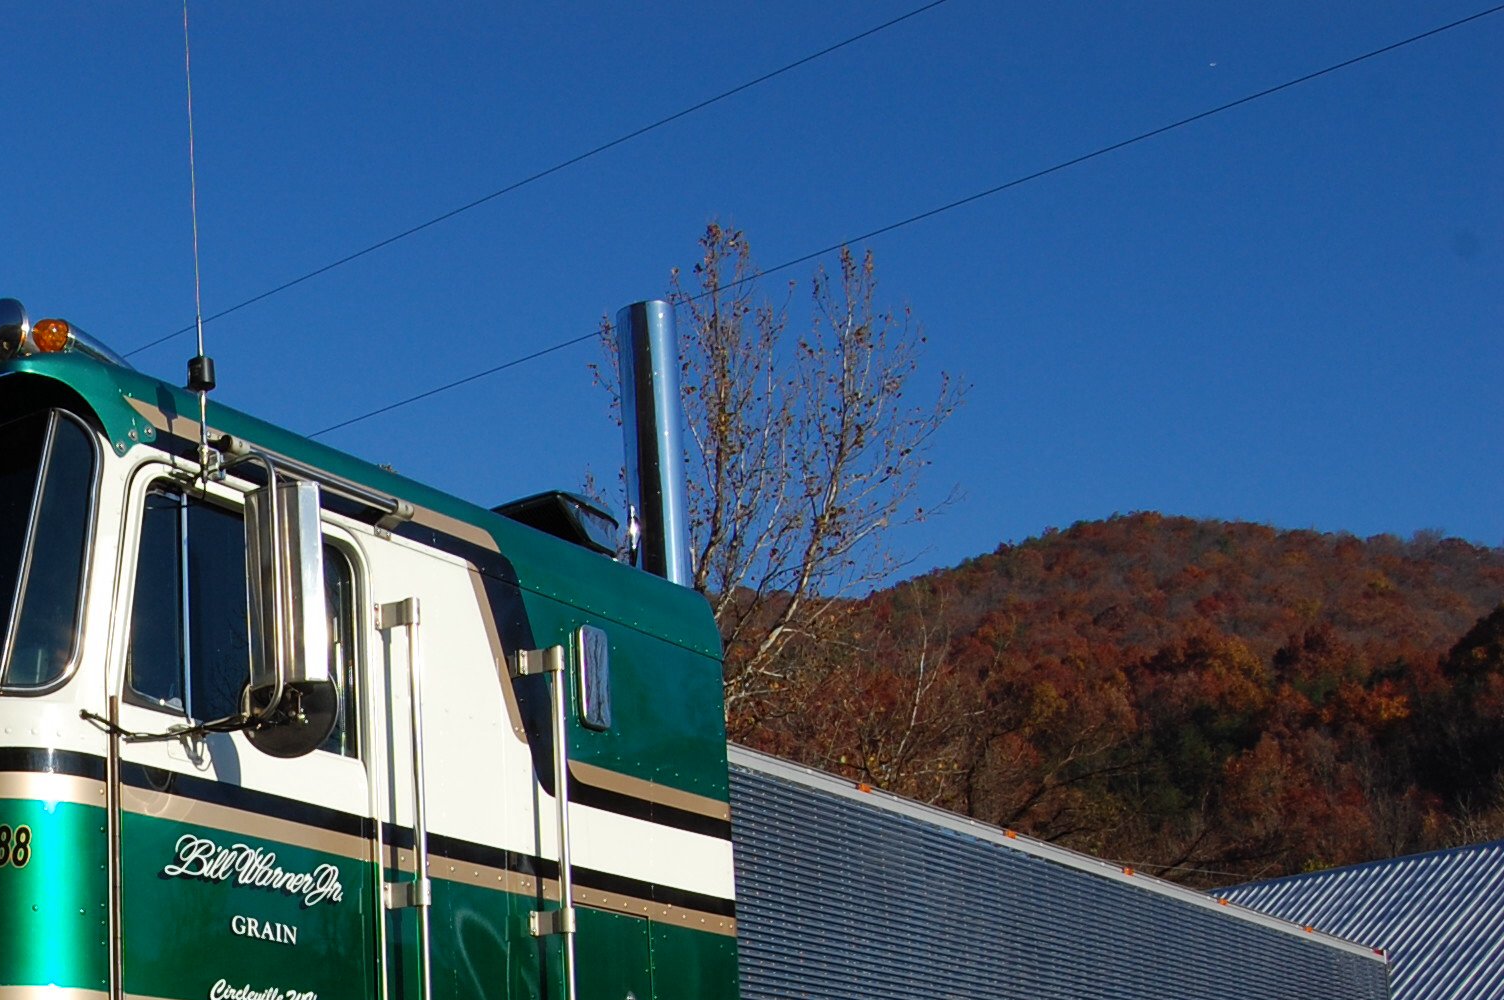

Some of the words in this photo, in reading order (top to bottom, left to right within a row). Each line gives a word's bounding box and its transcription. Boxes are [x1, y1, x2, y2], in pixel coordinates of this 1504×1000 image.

[164, 834, 238, 880] Bill
[232, 843, 316, 894] Warner
[304, 863, 344, 907] Jr.
[231, 915, 297, 945] GRAIN
